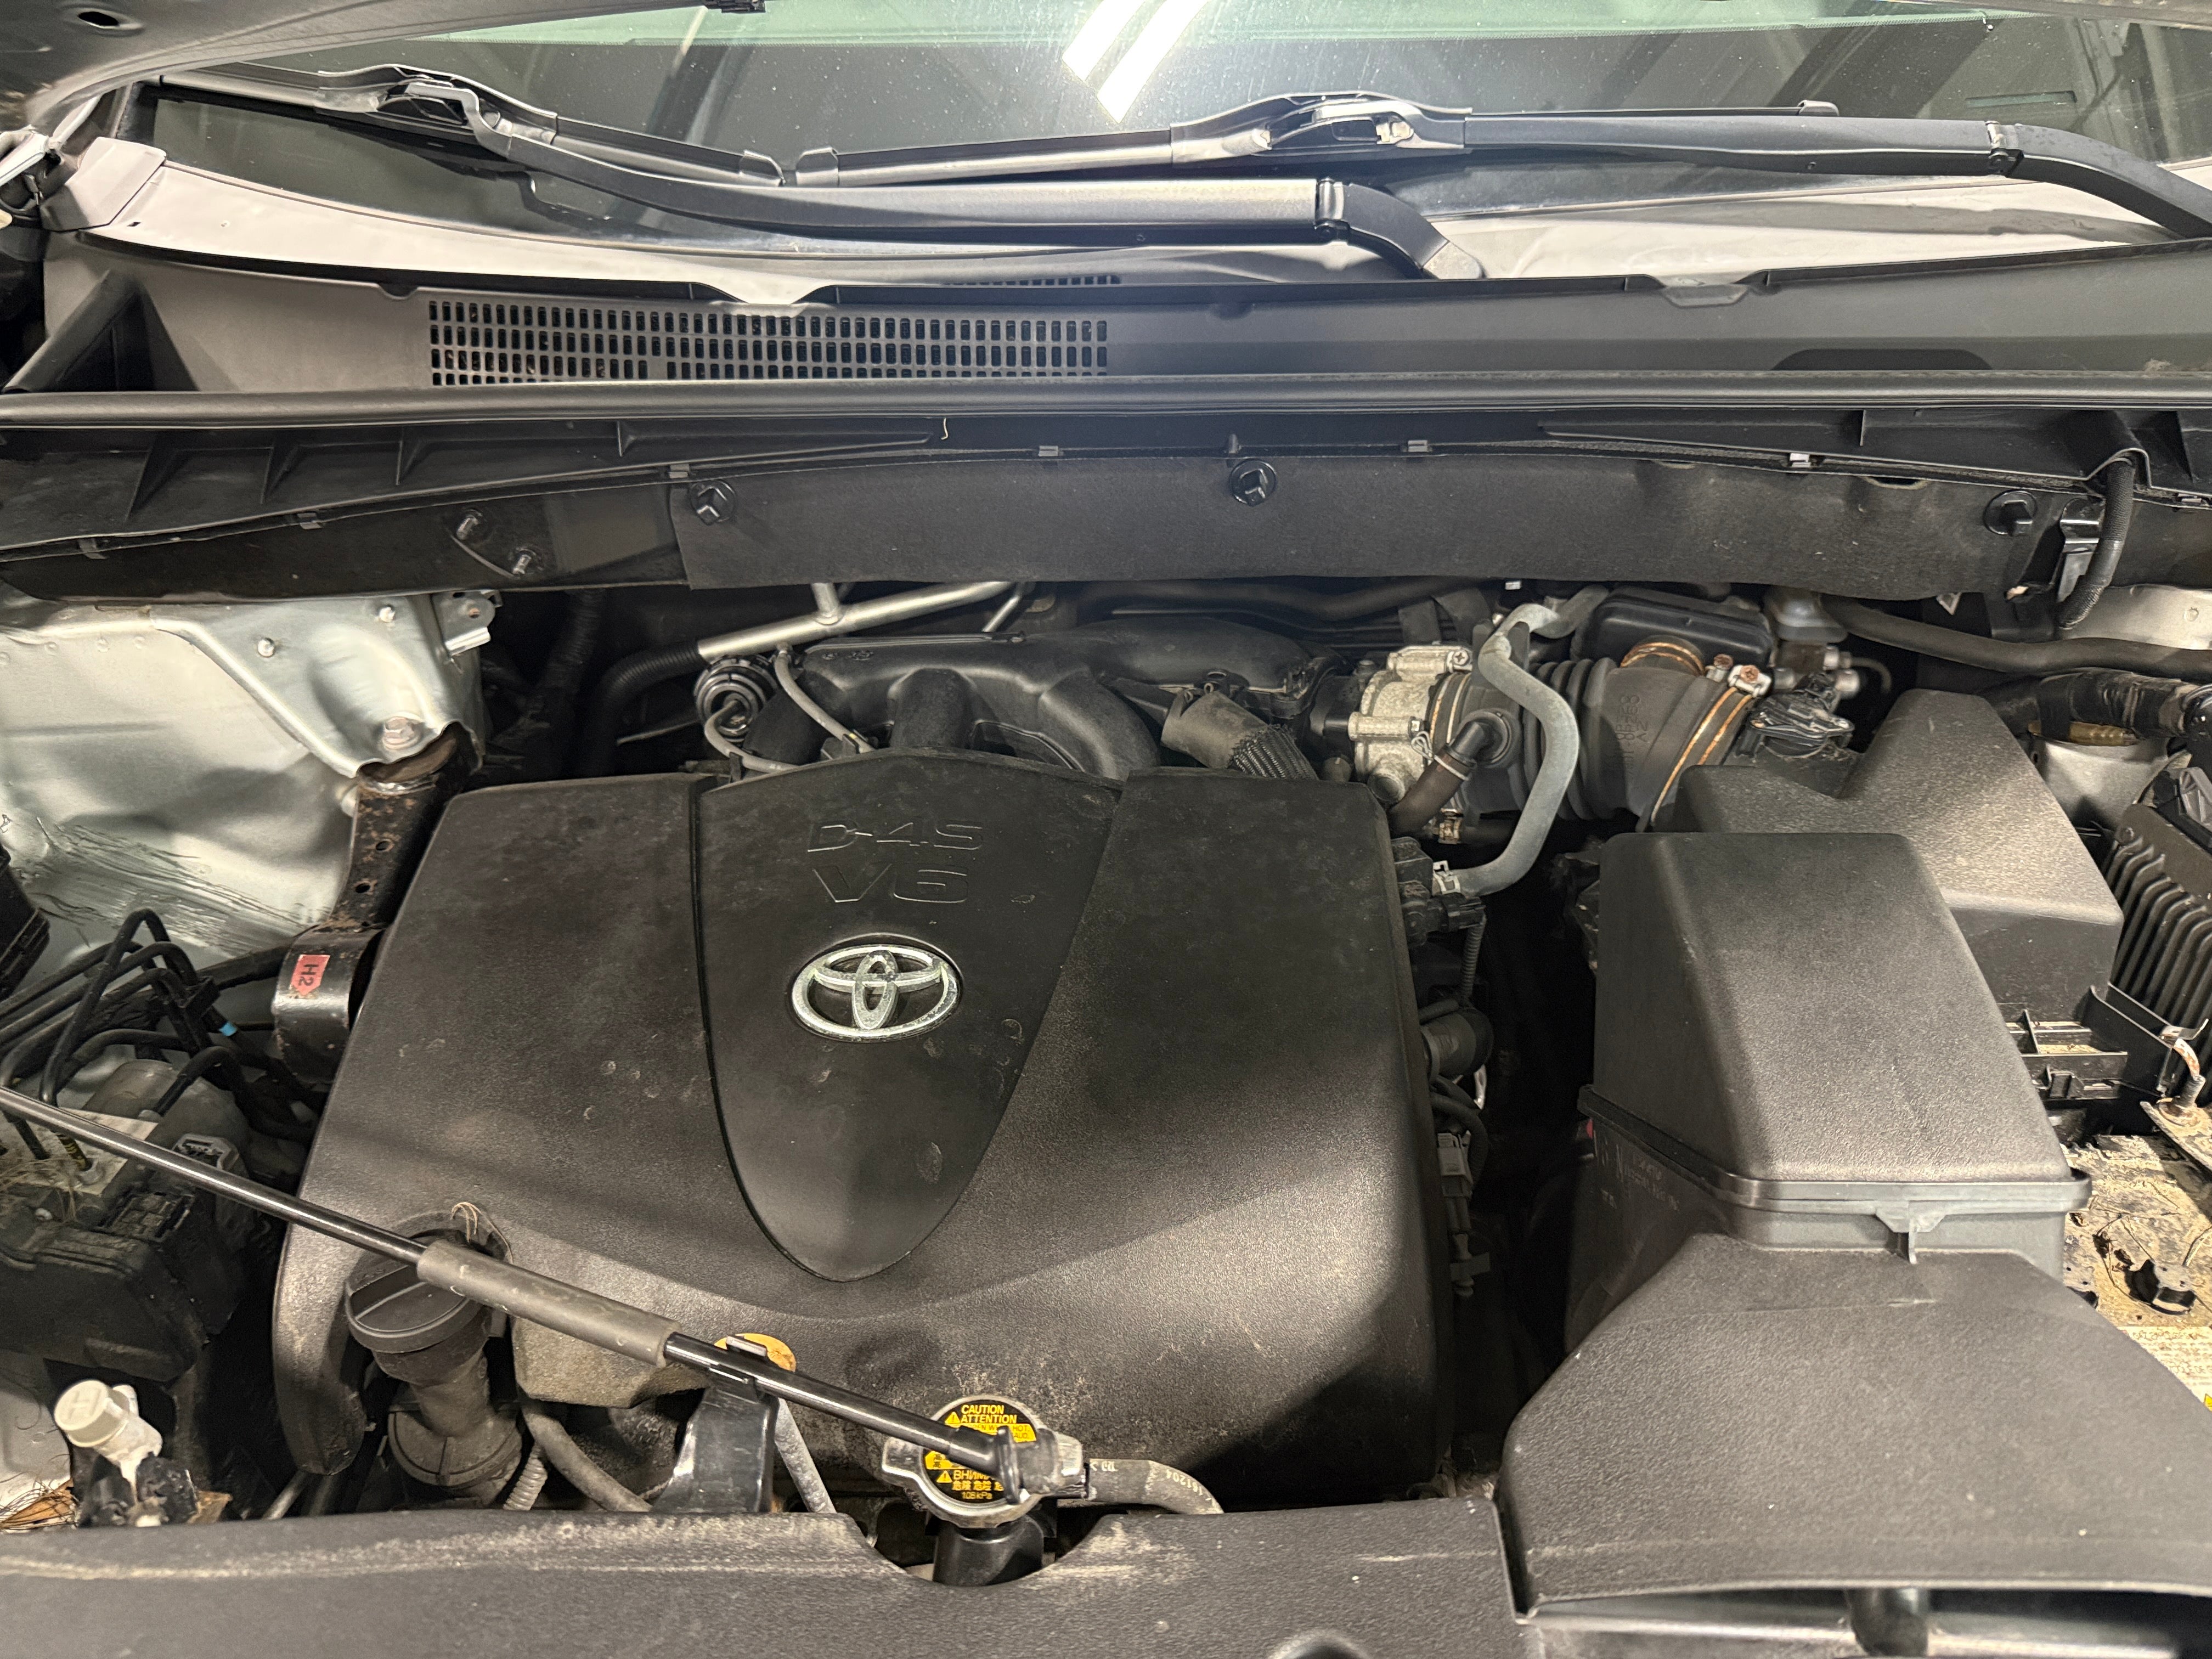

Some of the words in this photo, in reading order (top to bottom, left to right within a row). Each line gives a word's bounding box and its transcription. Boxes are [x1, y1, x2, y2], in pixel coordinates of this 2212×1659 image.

[808, 817, 983, 853] D-4S
[812, 863, 969, 904] V6
[298, 964, 319, 986] H2
[961, 1404, 1005, 1414] CAUTION
[961, 1414, 1017, 1424] ATTENTION
